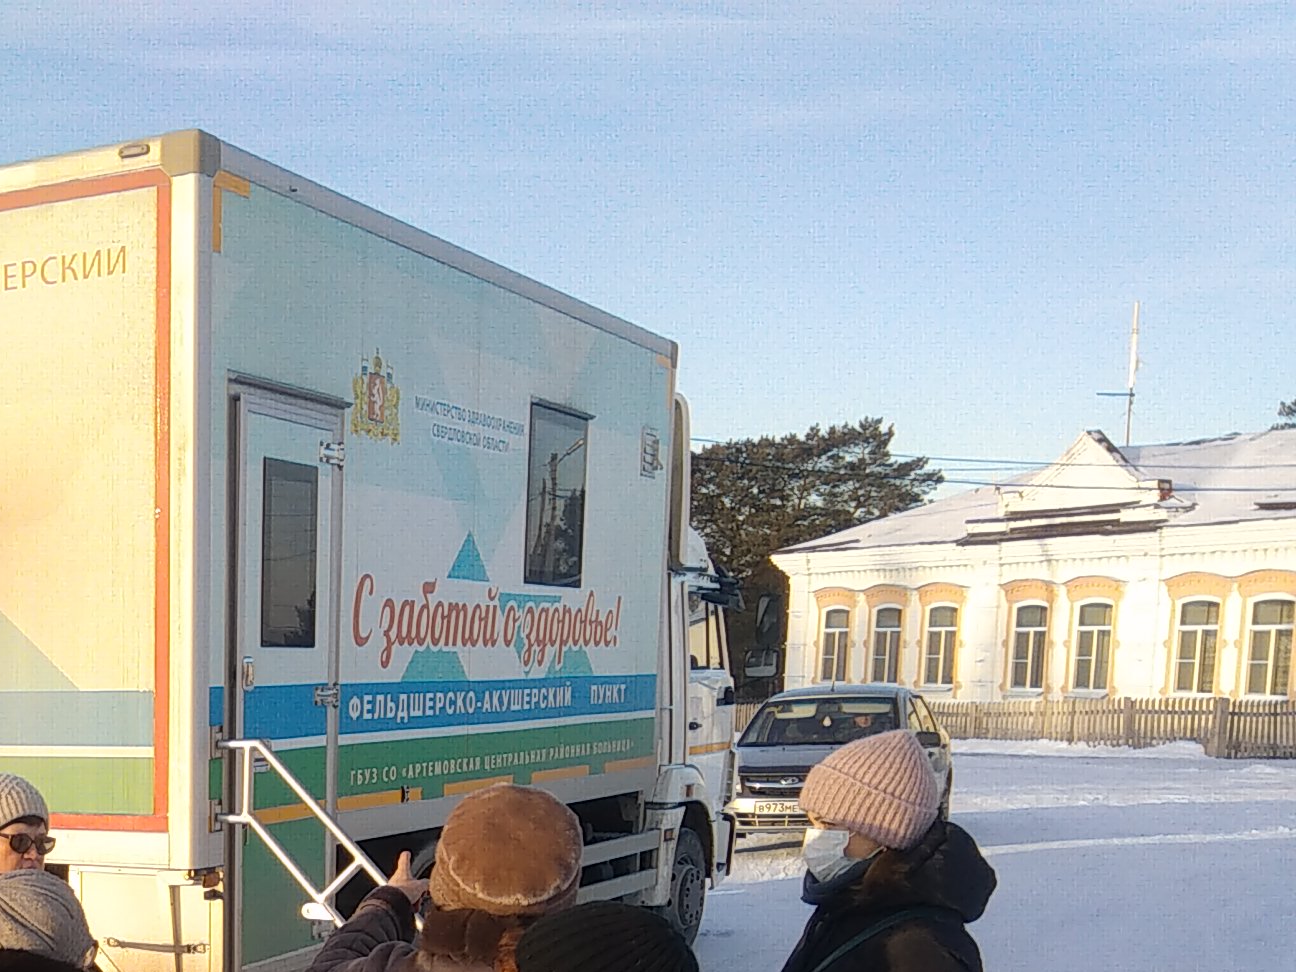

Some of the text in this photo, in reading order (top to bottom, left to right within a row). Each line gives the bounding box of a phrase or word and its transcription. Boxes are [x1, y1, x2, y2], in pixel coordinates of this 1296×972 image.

[352, 573, 623, 669] С заботой о здоровье!
[348, 681, 626, 723] ФЕЛЬДШЕРСКО-АКУШЕРСКИЙ ПУНКТ
[349, 767, 378, 786] ГБУЗ
[382, 765, 397, 782] СО
[484, 748, 546, 771] ЦЕНТРАЛЬНАЯ
[549, 742, 591, 761] РАЙОННАЯ
